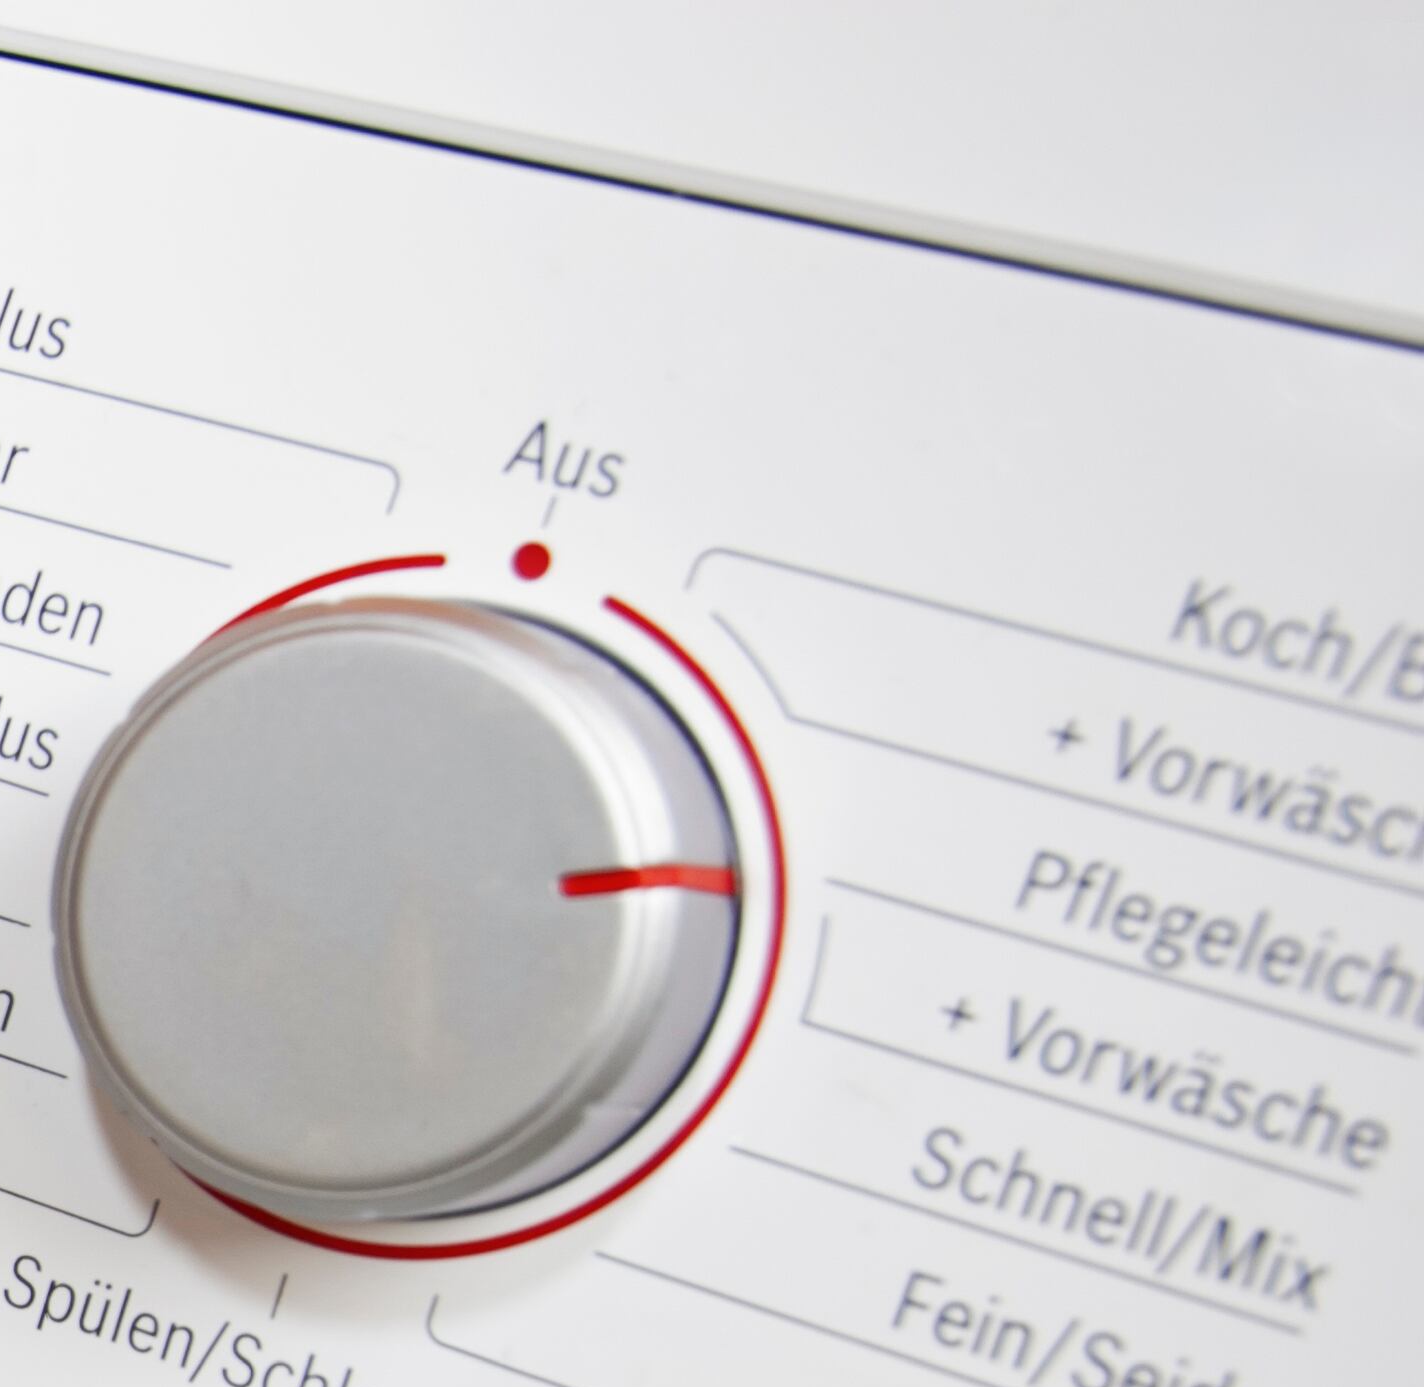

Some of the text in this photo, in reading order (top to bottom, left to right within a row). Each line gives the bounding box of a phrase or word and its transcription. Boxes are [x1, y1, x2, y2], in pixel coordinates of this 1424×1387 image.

[502, 419, 627, 499] Aus
[1014, 849, 1424, 1031] Pflegeleich
[1006, 996, 1390, 1171] Vorwäsche
[910, 1126, 1332, 1311] Schnell/Mix
